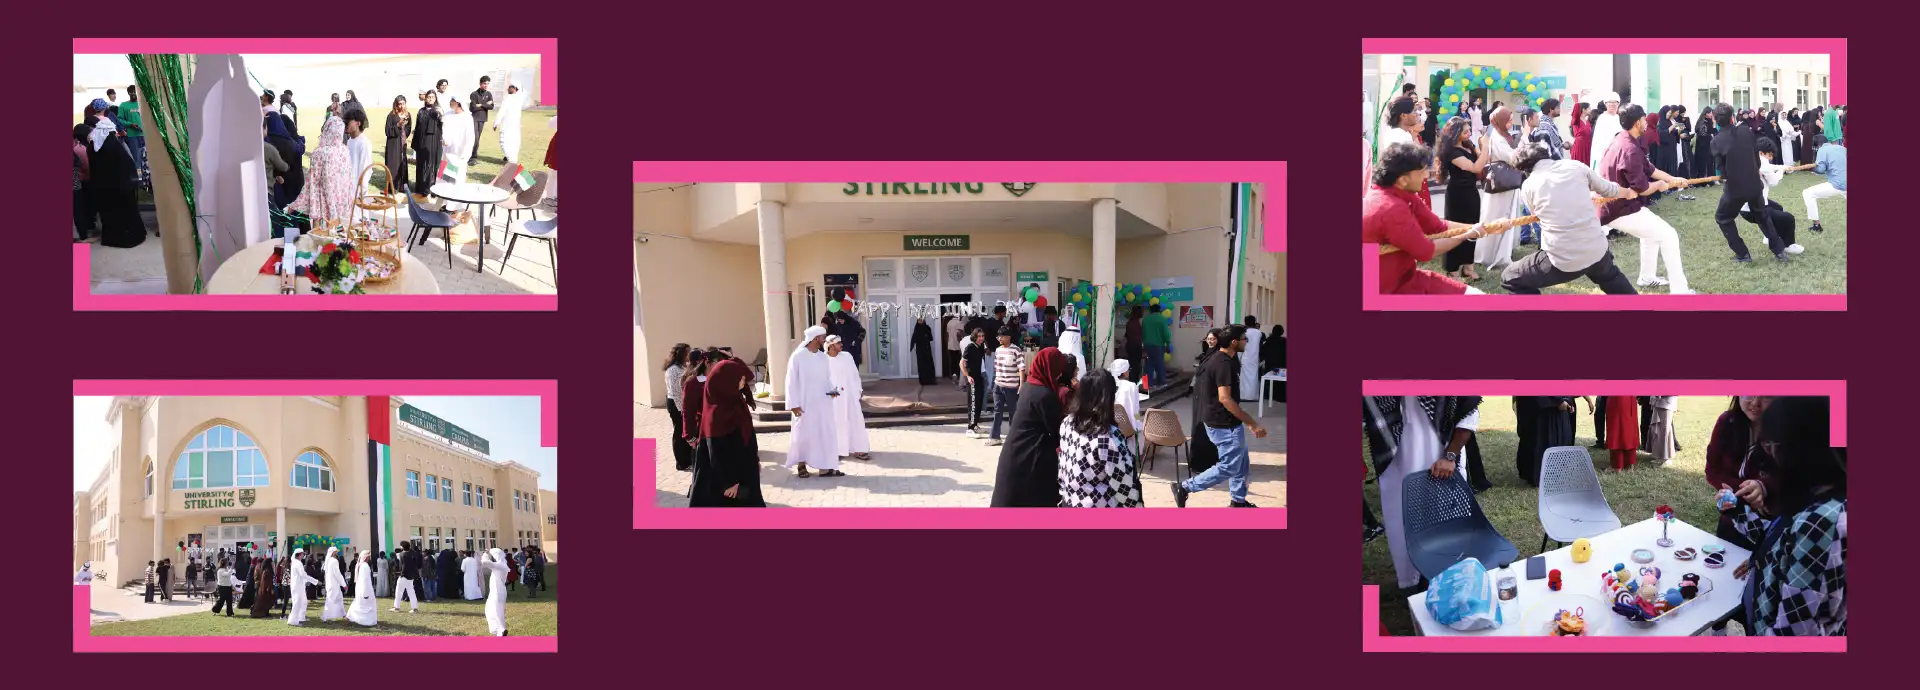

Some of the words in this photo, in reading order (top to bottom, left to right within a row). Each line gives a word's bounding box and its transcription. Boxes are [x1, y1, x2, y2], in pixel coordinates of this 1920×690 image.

[911, 238, 963, 247] WELCOME
[409, 414, 437, 432] STIRLING
[184, 499, 235, 509] STIRLING
